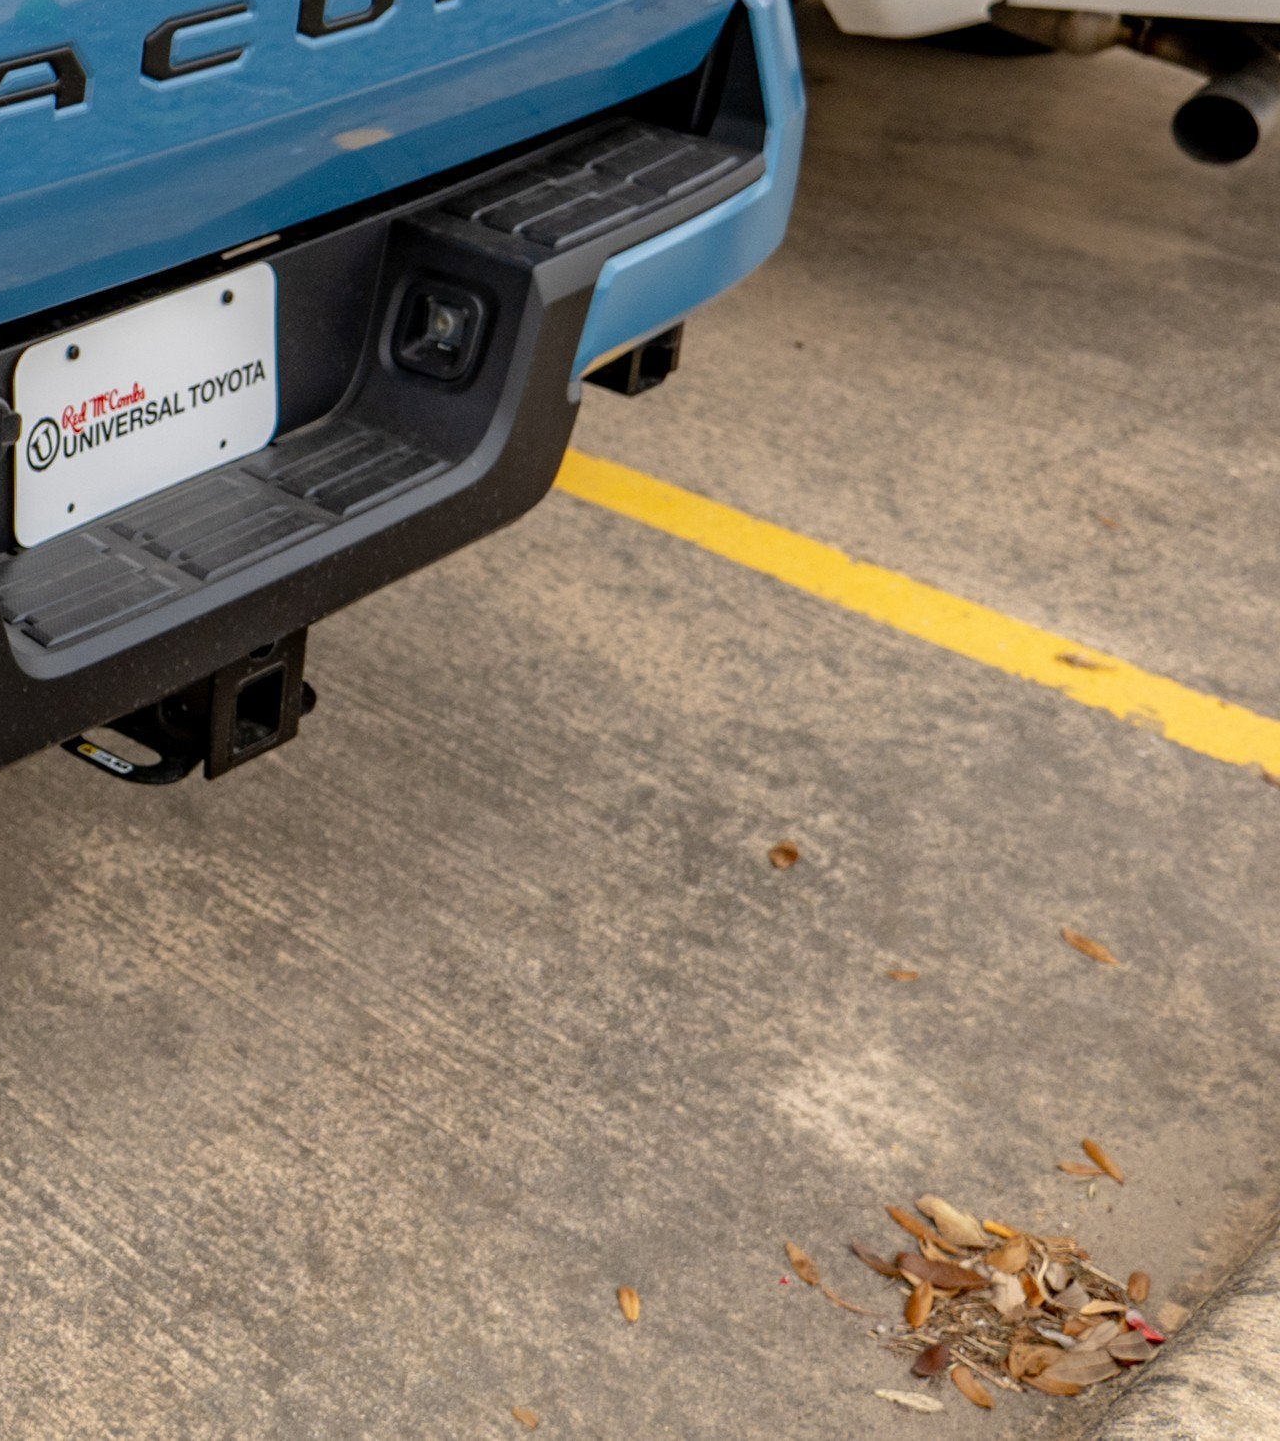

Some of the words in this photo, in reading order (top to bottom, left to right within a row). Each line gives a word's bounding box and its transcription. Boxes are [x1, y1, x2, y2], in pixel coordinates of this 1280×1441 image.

[62, 402, 87, 434] Red
[63, 392, 185, 459] UNIVERSAL
[188, 359, 266, 409] TOYOTA
